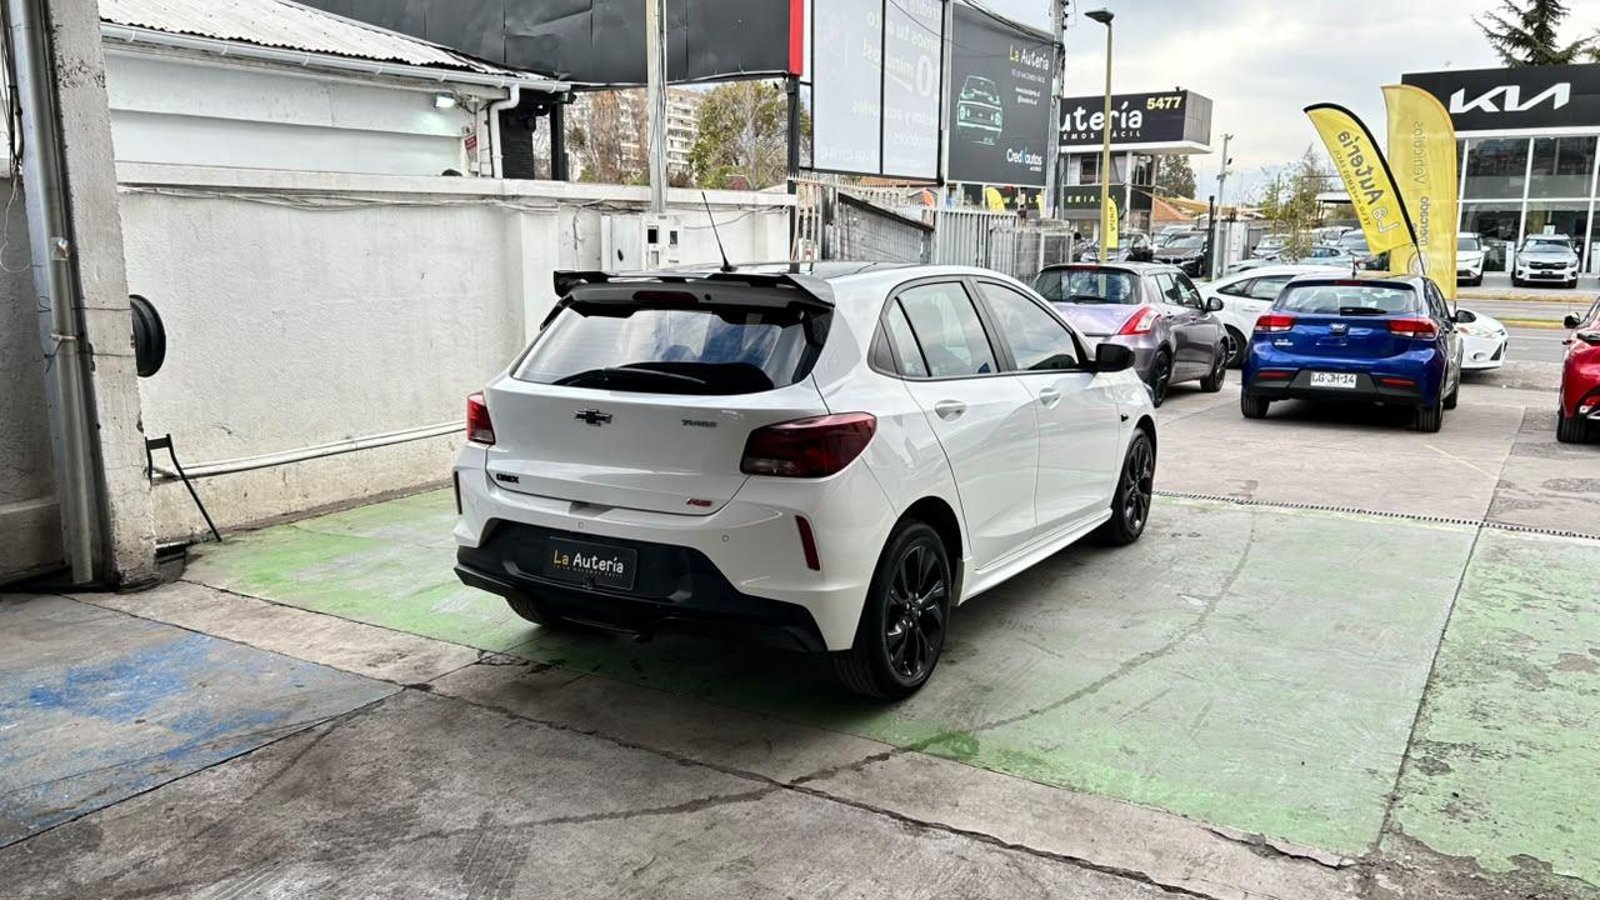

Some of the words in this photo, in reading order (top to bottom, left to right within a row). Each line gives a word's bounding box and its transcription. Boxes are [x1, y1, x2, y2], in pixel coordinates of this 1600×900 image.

[1010, 44, 1020, 62] La
[1146, 96, 1182, 110] 5477
[1450, 82, 1571, 114] KIA
[1060, 101, 1143, 132] utería
[1063, 132, 1096, 140] EMOS
[553, 549, 570, 566] La
[573, 552, 624, 574] Autería
